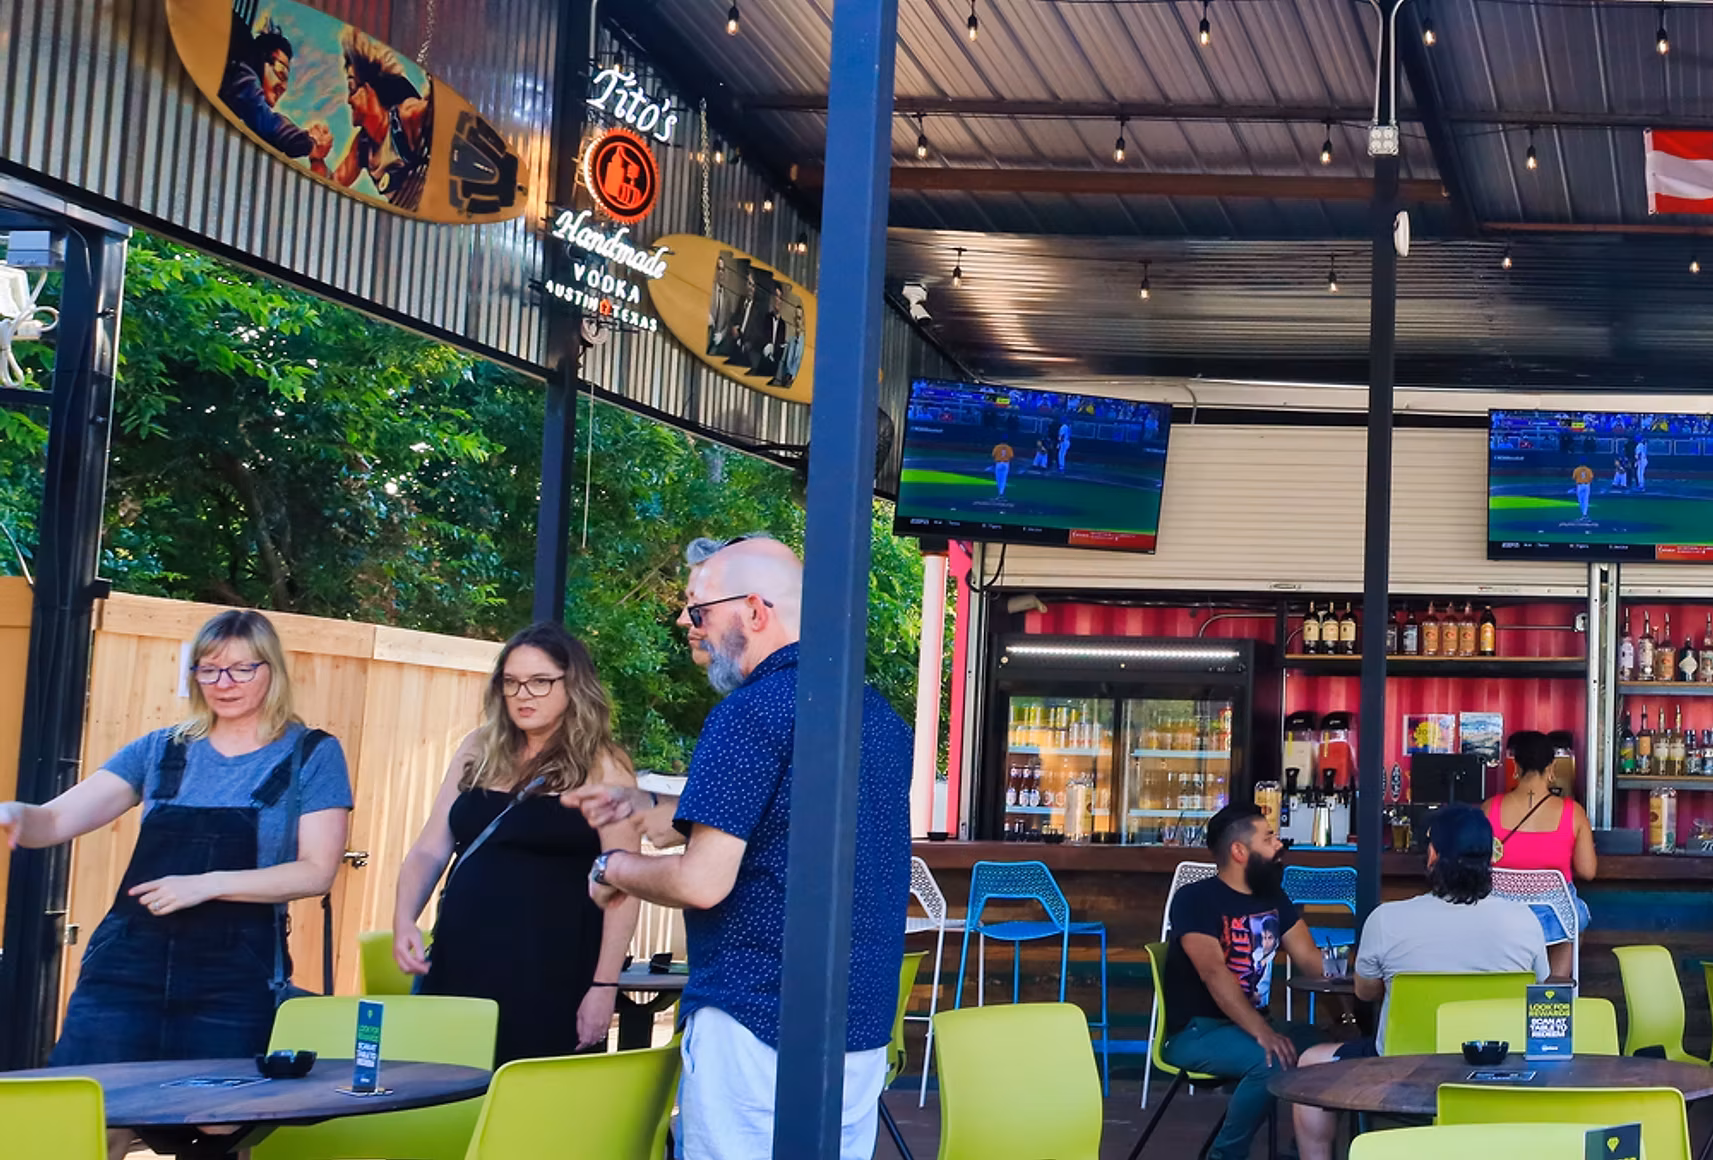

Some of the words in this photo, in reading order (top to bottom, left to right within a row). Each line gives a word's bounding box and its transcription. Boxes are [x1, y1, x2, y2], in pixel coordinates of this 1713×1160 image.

[586, 69, 677, 142] Tito's
[552, 208, 669, 280] Handmade
[545, 280, 599, 311] AUSTIN
[612, 305, 658, 332] TEXAS
[573, 262, 640, 304] VODKA
